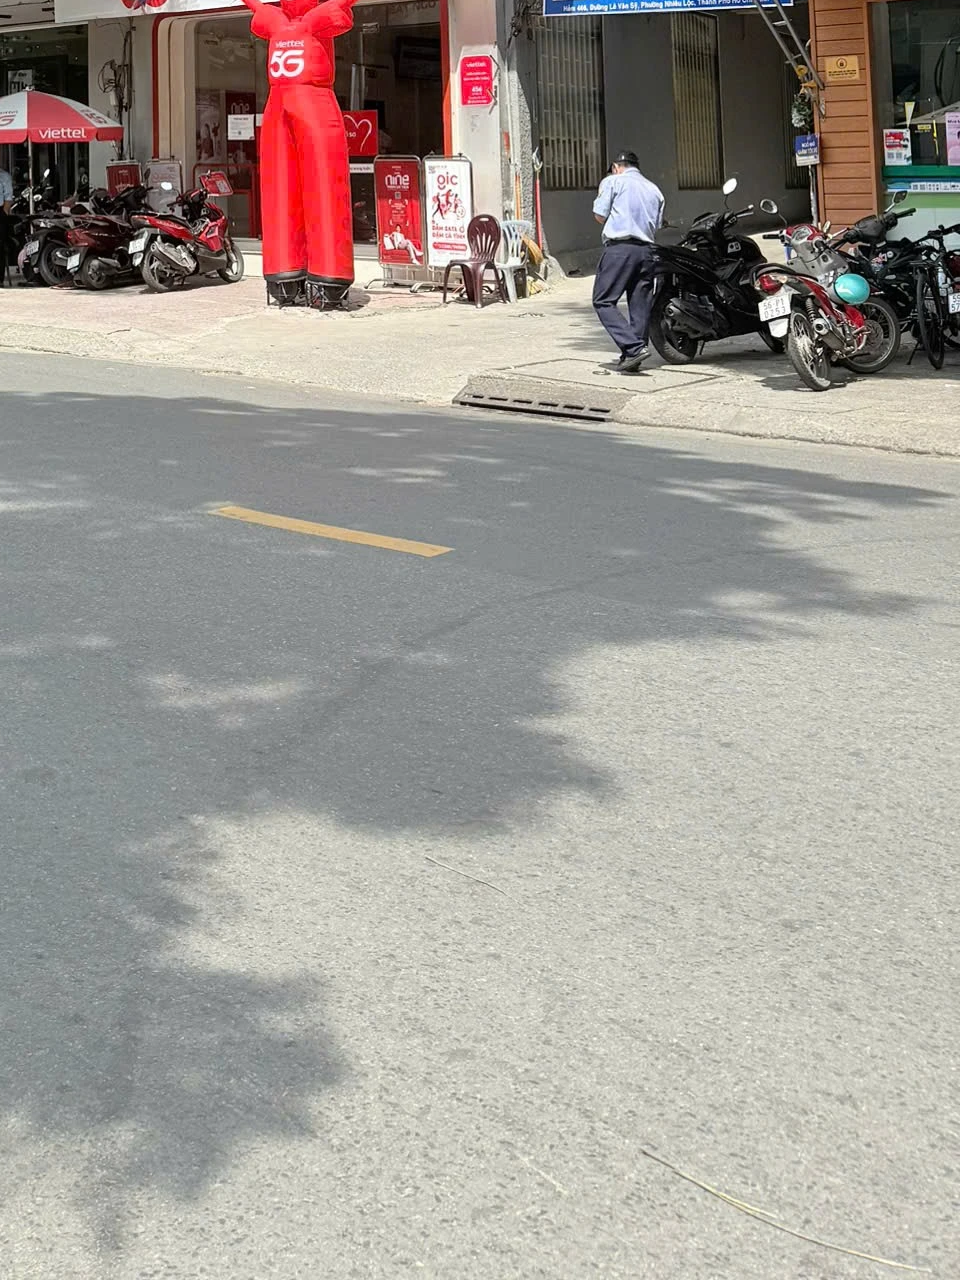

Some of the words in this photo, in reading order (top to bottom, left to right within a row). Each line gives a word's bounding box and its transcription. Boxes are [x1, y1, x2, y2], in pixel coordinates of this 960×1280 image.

[276, 39, 304, 48] viettel
[270, 49, 305, 78] 5G
[38, 127, 86, 139] viettel
[384, 174, 410, 186] nine
